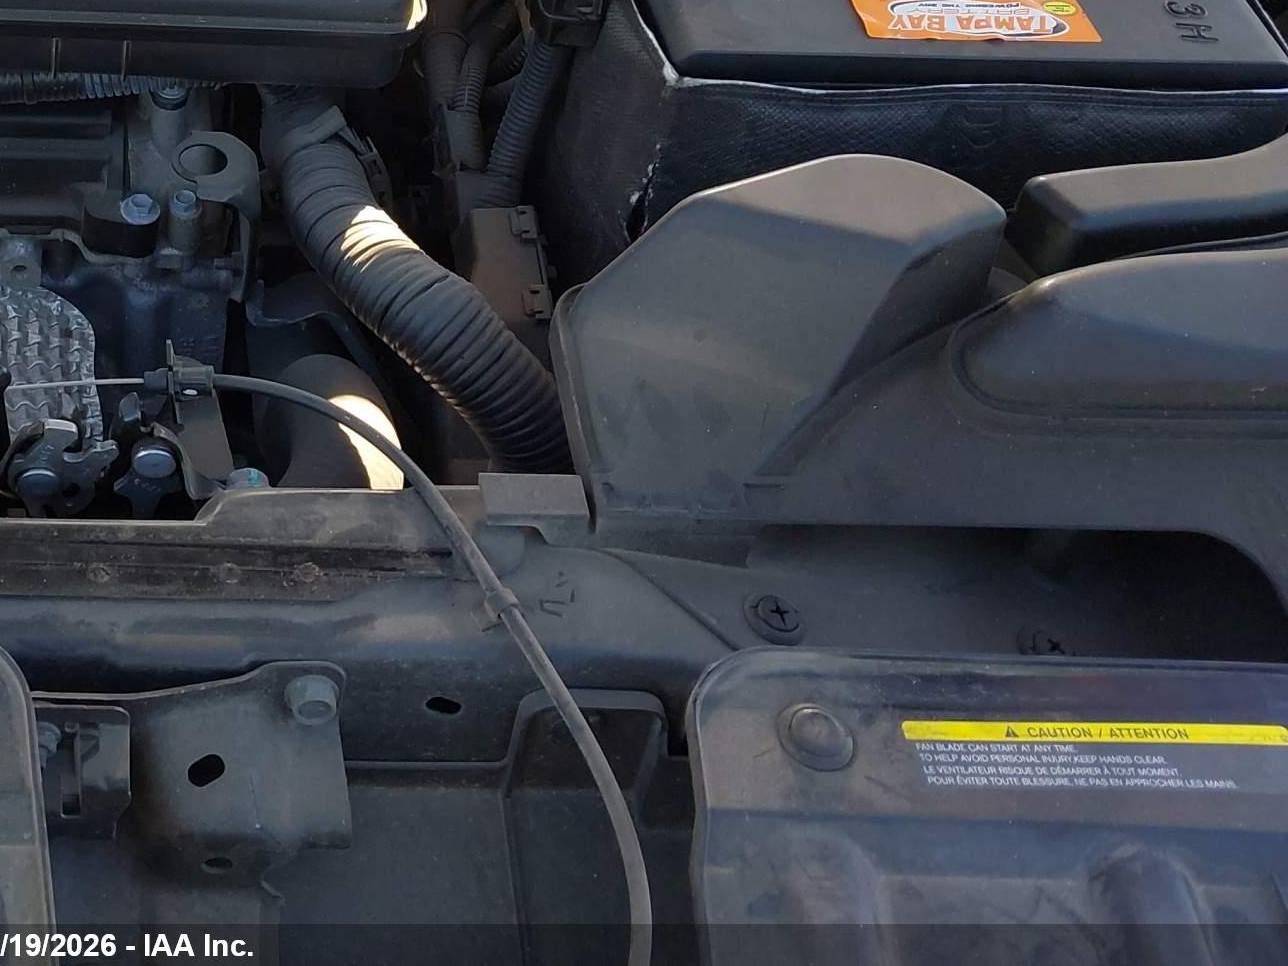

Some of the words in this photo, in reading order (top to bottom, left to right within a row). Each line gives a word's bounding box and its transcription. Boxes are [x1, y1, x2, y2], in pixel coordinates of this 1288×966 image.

[888, 13, 946, 31] BAY
[956, 14, 1053, 33] TAMPA
[1027, 727, 1093, 739] CAUTION
[1109, 728, 1189, 740] ATTENTION
[915, 743, 934, 751] FAN
[936, 743, 965, 751] BLADE
[968, 744, 988, 752] CAN
[991, 744, 1018, 752] START
[1034, 745, 1052, 753] ANY
[920, 753, 933, 762] TO
[934, 753, 958, 762] HELP
[961, 754, 988, 762] AVOID
[990, 754, 1040, 763] PERSONAL
[1099, 756, 1132, 764] HANDS
[924, 766, 936, 774] LE
[937, 766, 997, 774] VENTILATEUR
[998, 767, 1034, 775] RISQUE
[1036, 767, 1048, 775] DE
[1113, 768, 1136, 776] TOUT
[928, 777, 955, 785] POUR
[989, 777, 1018, 786] TOUTE
[1090, 778, 1108, 786] PAS
